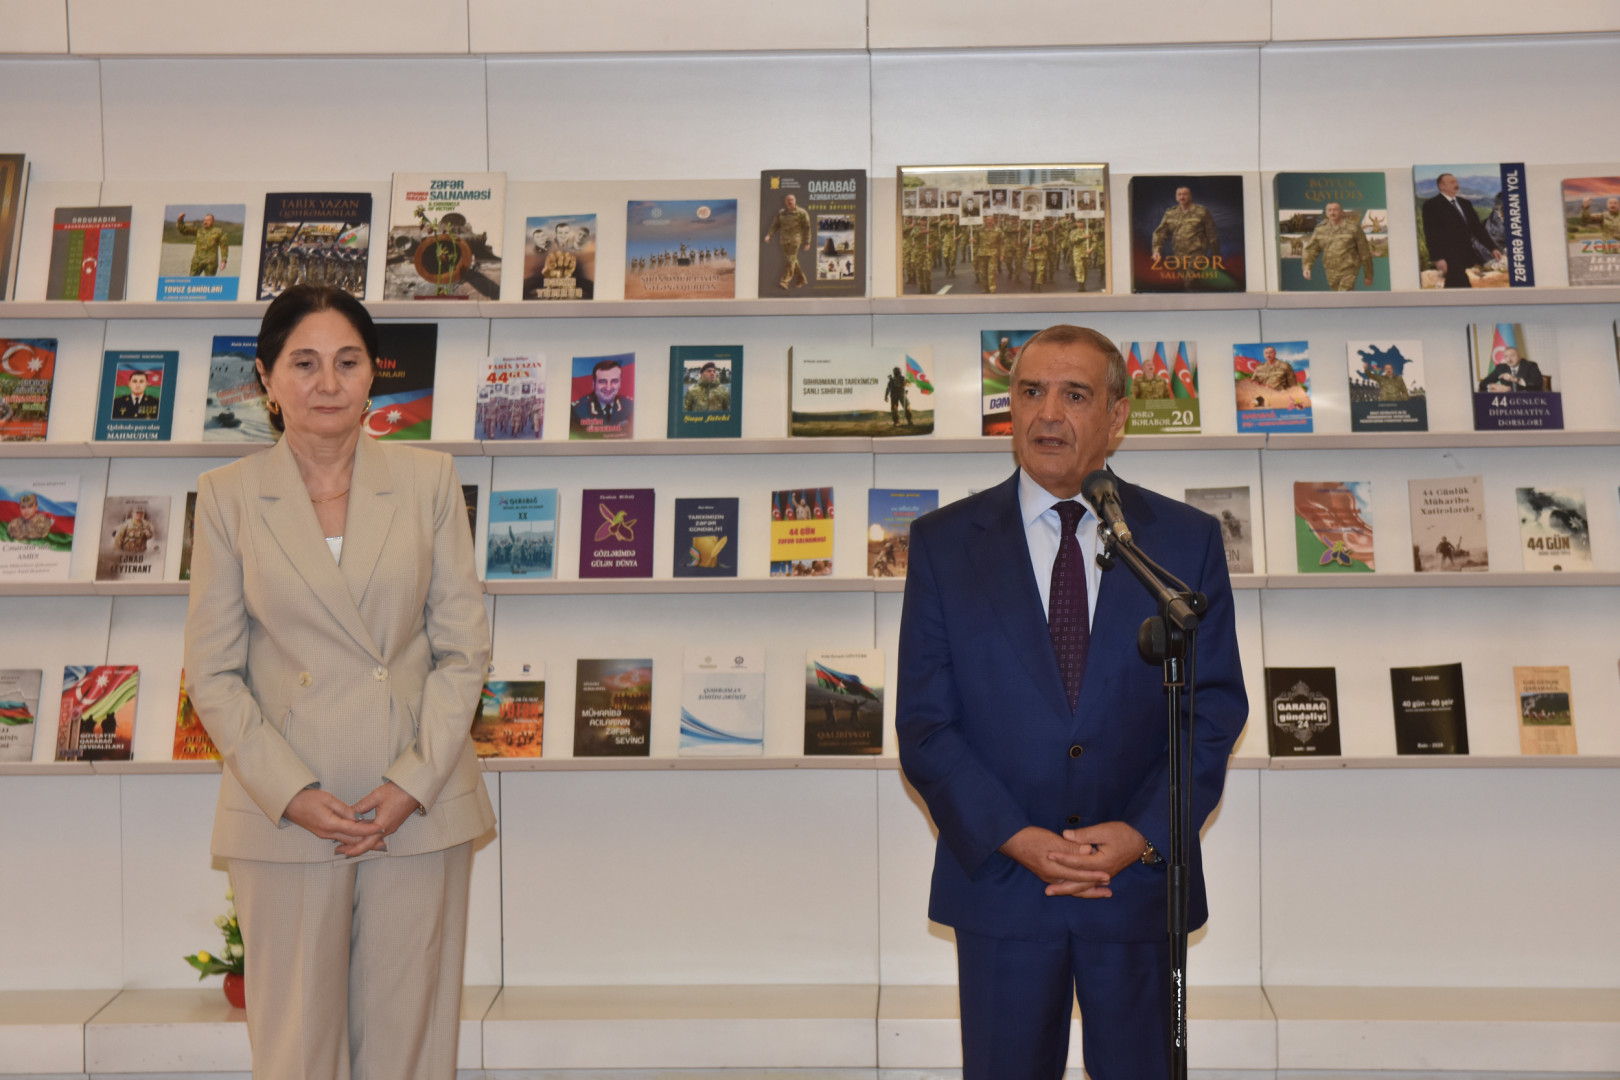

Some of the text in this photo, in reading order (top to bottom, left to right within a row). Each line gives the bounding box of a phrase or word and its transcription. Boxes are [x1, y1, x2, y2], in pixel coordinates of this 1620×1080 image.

[430, 180, 464, 190] ZƏFƏR
[808, 179, 856, 193] QARABAĞ
[430, 189, 491, 200] SALNAMƏSİ
[320, 200, 359, 208] YAZAN
[1507, 170, 1526, 282] ZƏFƏRƏ APARAN YOL
[1151, 255, 1226, 270] ZƏFƏR
[487, 371, 508, 384] 44
[1491, 396, 1548, 407] 44 GÜNLÜK
[1489, 408, 1550, 416] DİPLOMATİYA
[1172, 411, 1193, 425] 20
[1498, 419, 1543, 427] DƏRSLƏRİ
[1436, 487, 1469, 496] Günlük
[518, 512, 528, 520] XX
[789, 526, 816, 536] 44 GÜN
[1527, 533, 1570, 550] 44 GÜN
[594, 549, 636, 558] GÖZLƏRİMDƏ
[591, 560, 638, 568] GÜLƏN DÜNYA
[111, 565, 152, 574] LEYTENANT
[1278, 702, 1327, 711] QARABAĞ
[582, 708, 622, 718] MÜHARİBƏ
[1297, 720, 1309, 728] 24
[615, 735, 645, 745] SEVİNCİ
